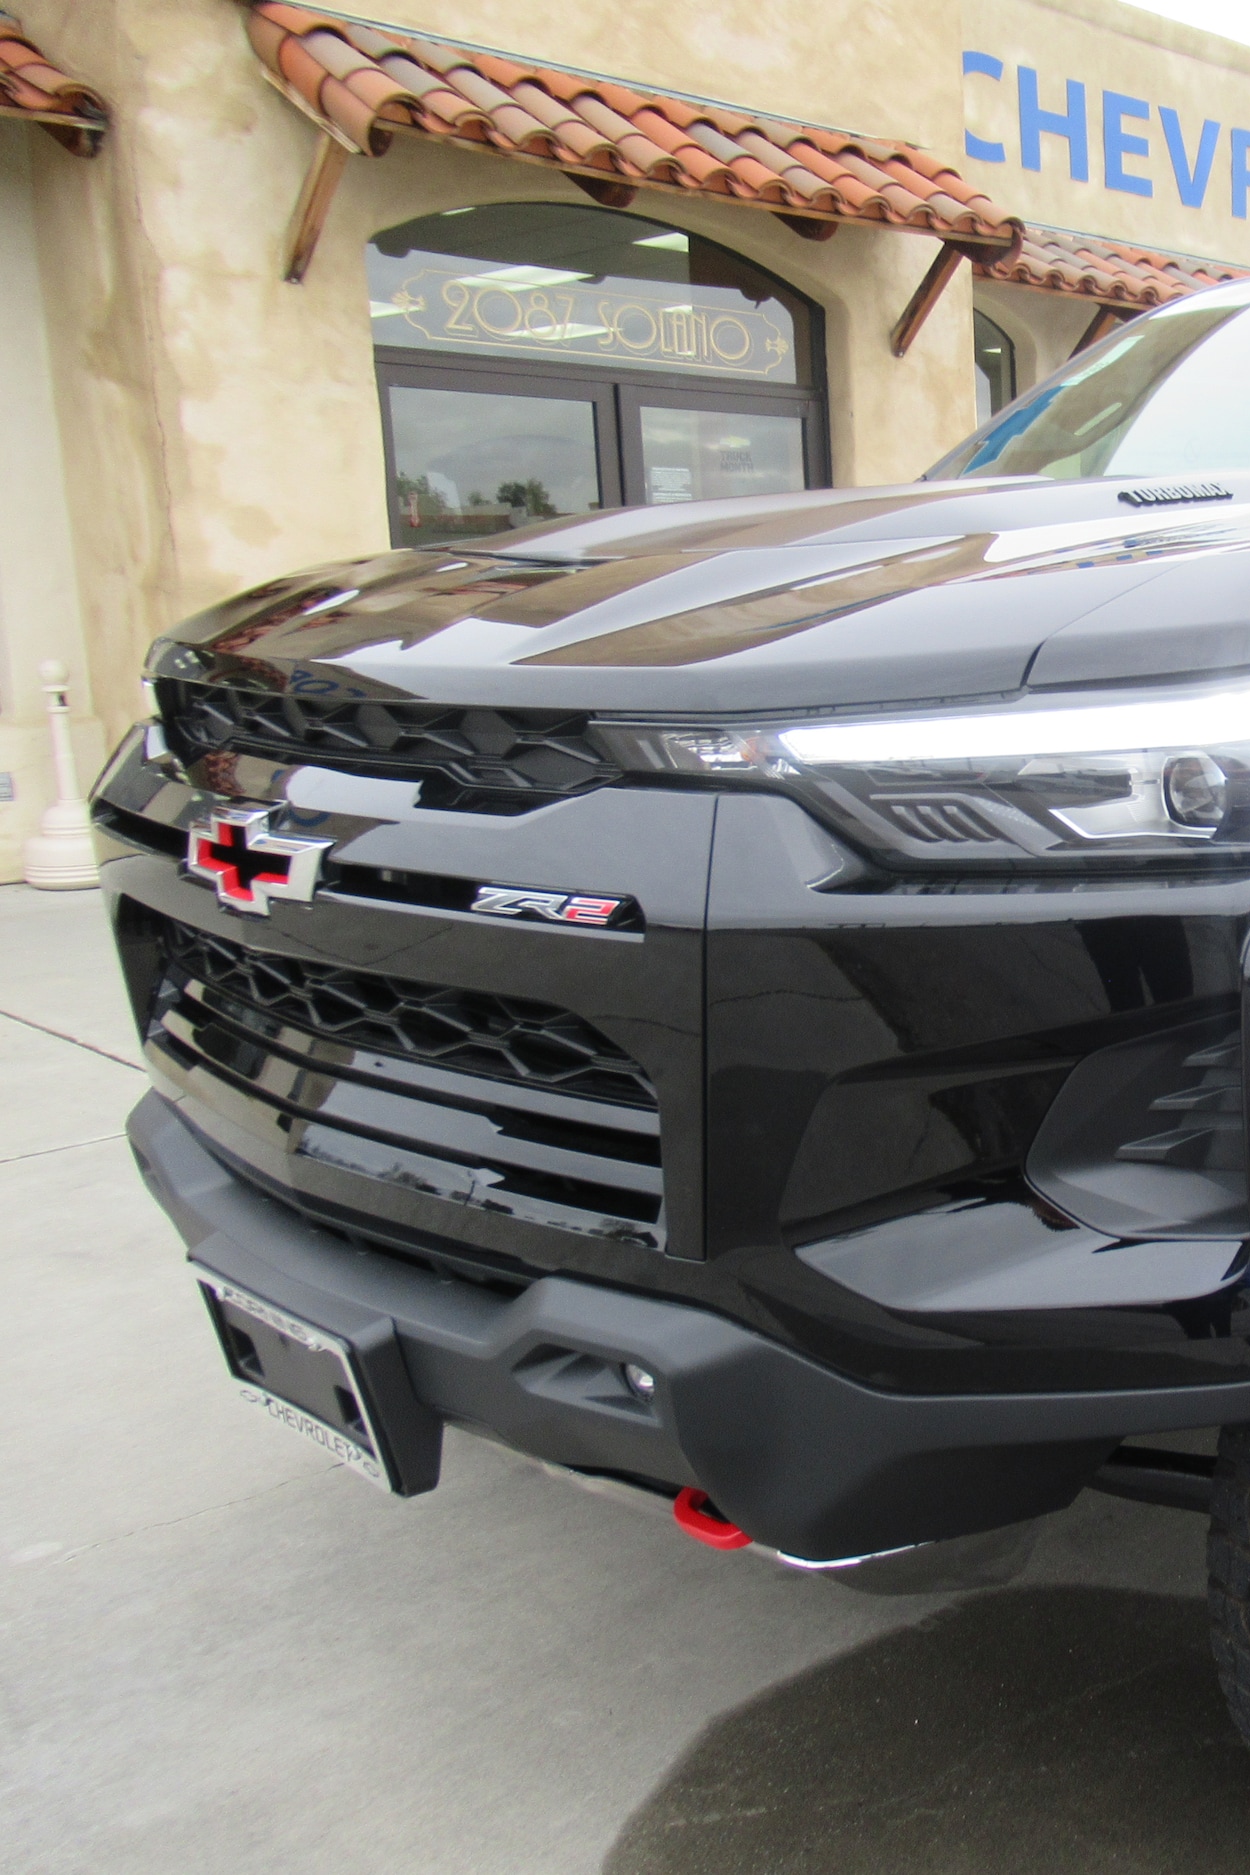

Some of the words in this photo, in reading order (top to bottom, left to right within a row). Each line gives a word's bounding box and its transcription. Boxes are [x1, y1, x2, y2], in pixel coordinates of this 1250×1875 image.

[441, 281, 575, 346] 2087
[597, 301, 751, 365] SOLANO
[1118, 482, 1233, 507] TURBOMAX
[470, 885, 624, 925] ZR2
[267, 1400, 351, 1462] CHEVROLET
